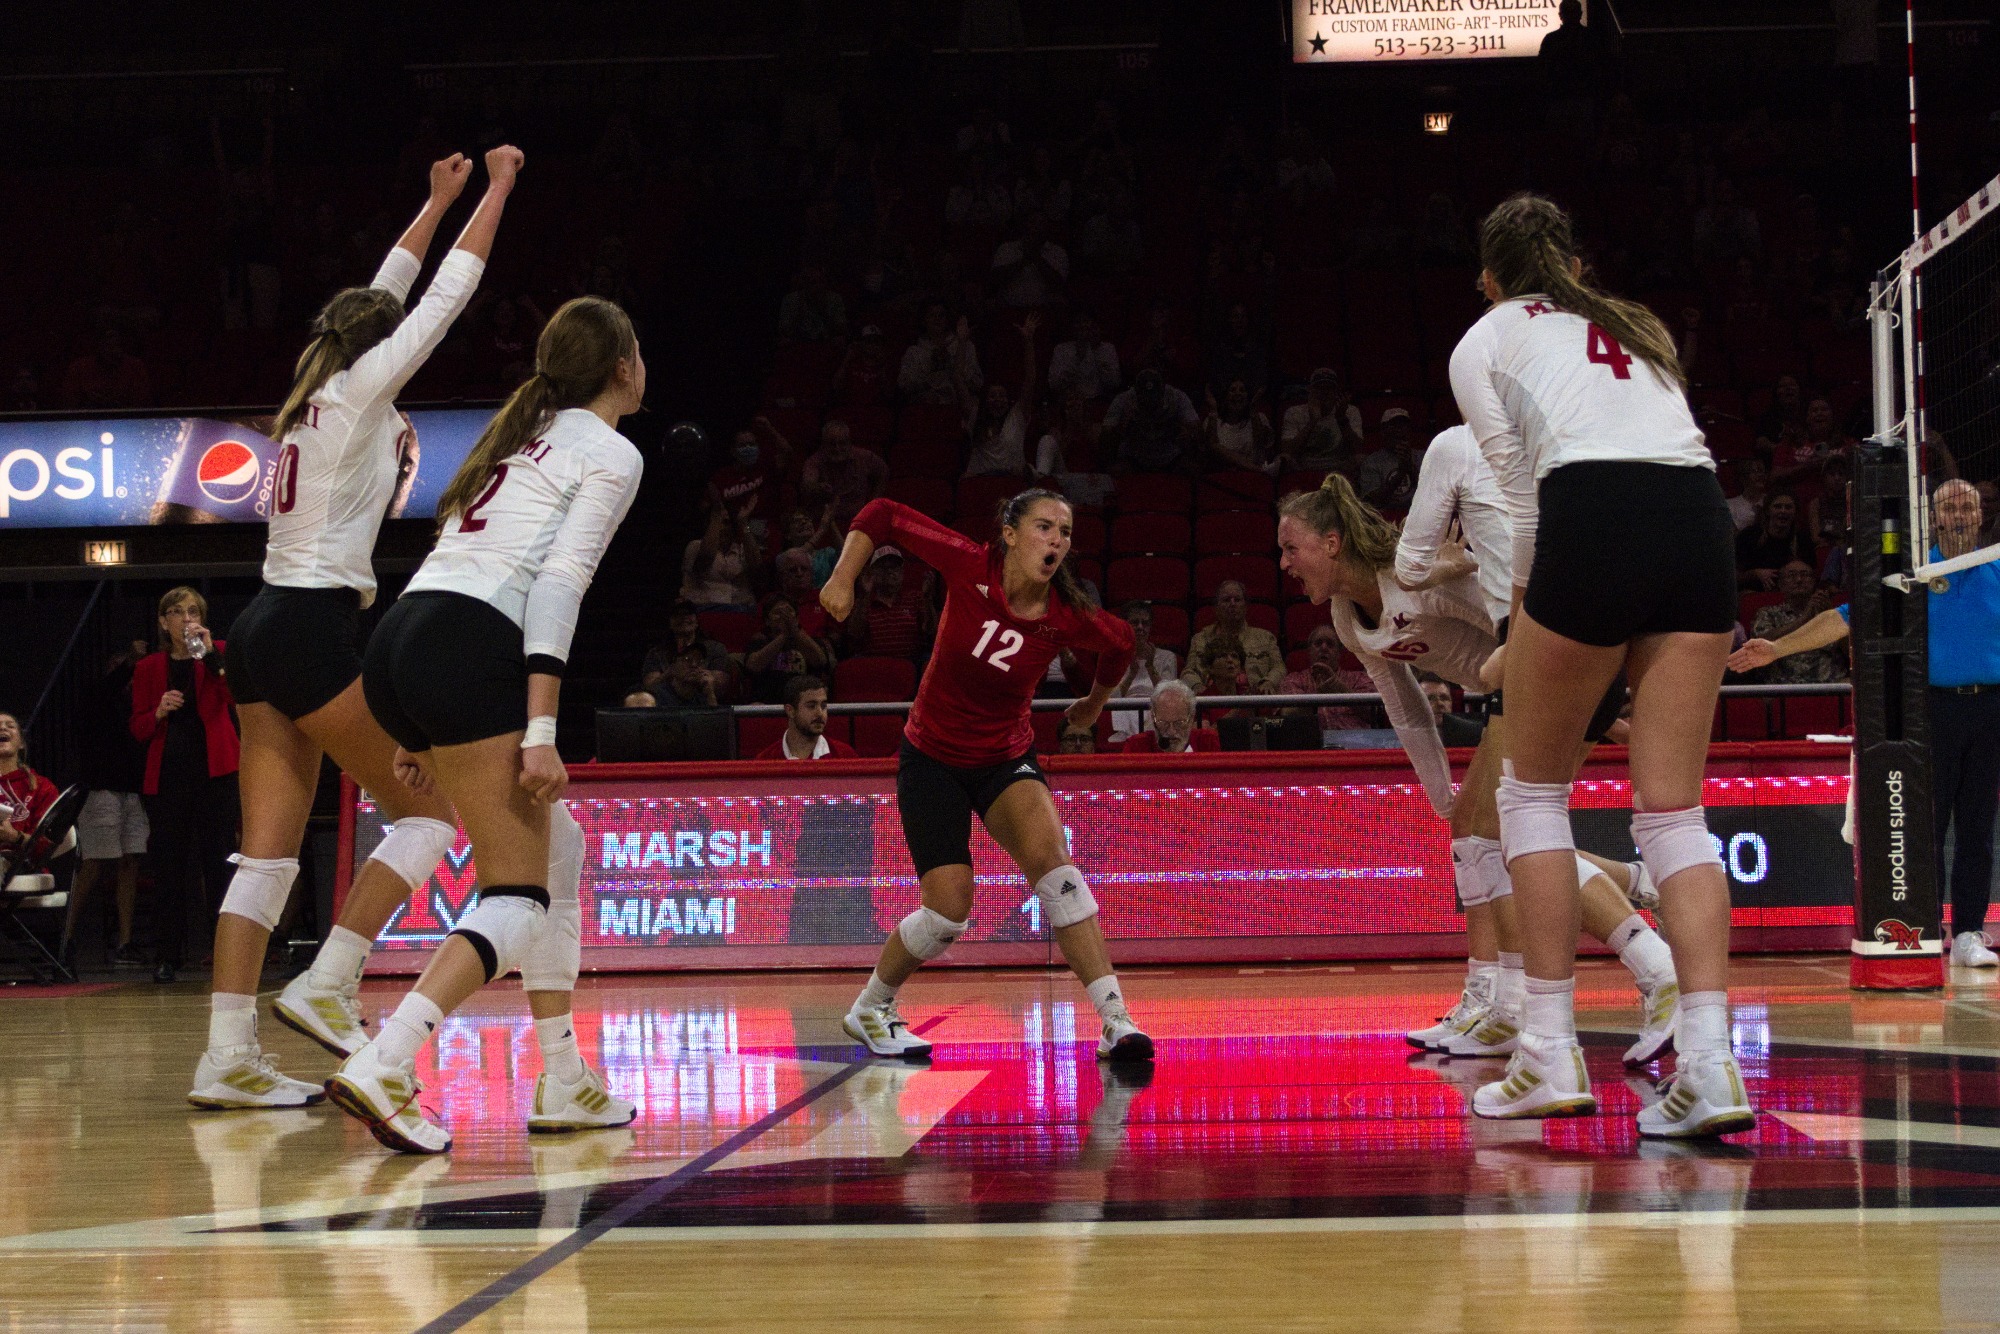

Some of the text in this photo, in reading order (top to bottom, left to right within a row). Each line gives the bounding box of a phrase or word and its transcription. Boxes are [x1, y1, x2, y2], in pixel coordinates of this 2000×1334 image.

[1331, 14, 1549, 33] CUSTOM FRAMING-ART-PRINTS
[1470, 0, 1557, 10] GALLER
[1374, 35, 1506, 56] 513-523-3111
[1425, 114, 1452, 129] EXIT
[1586, 322, 1633, 380] 4
[254, 459, 278, 517] pepsi
[458, 462, 509, 533] 2
[89, 542, 124, 562] EXIT
[971, 619, 1024, 673] 12
[602, 831, 772, 869] MARSH
[1885, 770, 1908, 901] sports imports
[600, 897, 737, 936] MIAMI
